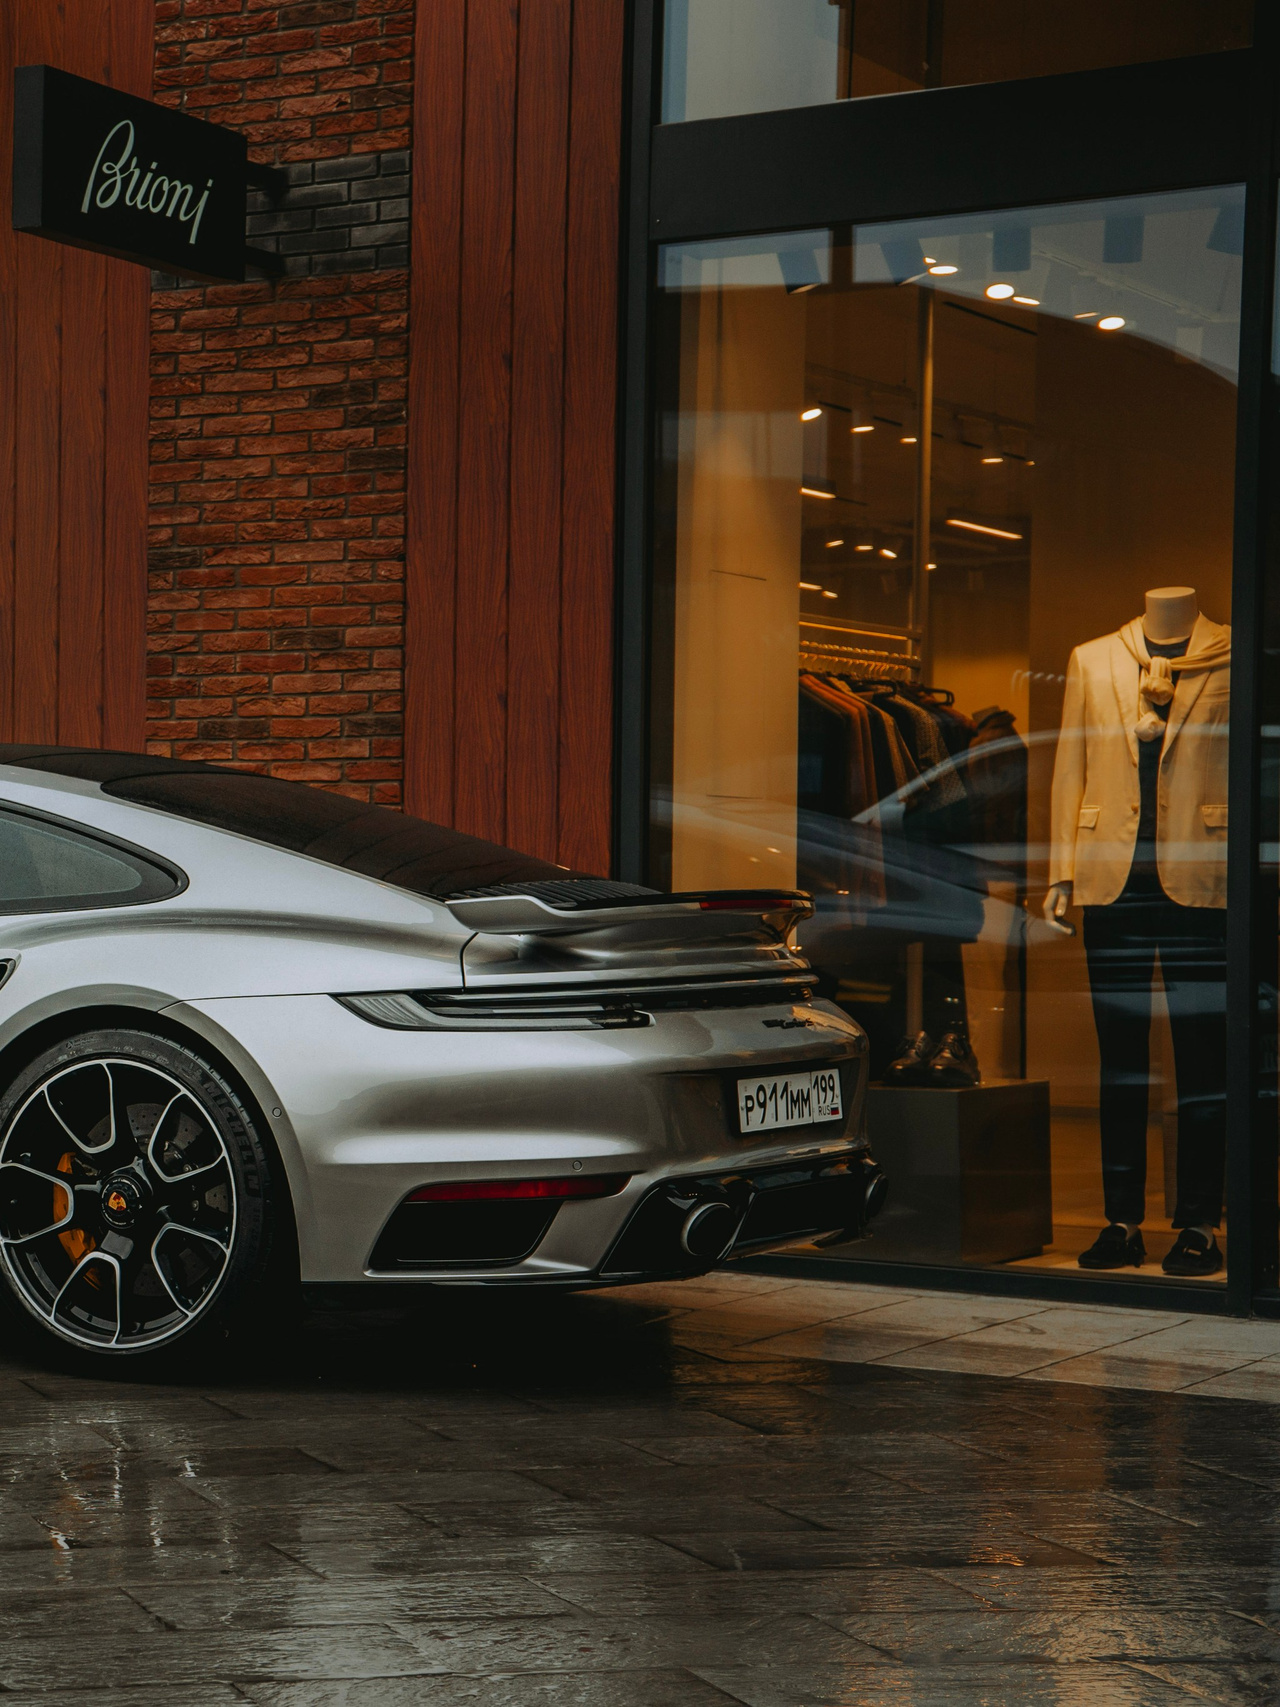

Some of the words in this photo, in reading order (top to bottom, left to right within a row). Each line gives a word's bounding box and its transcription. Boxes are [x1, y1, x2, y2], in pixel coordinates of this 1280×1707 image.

[81, 119, 214, 245] Brioni
[744, 1081, 812, 1127] P911MM
[813, 1073, 836, 1105] 199
[818, 1104, 831, 1116] RUS
